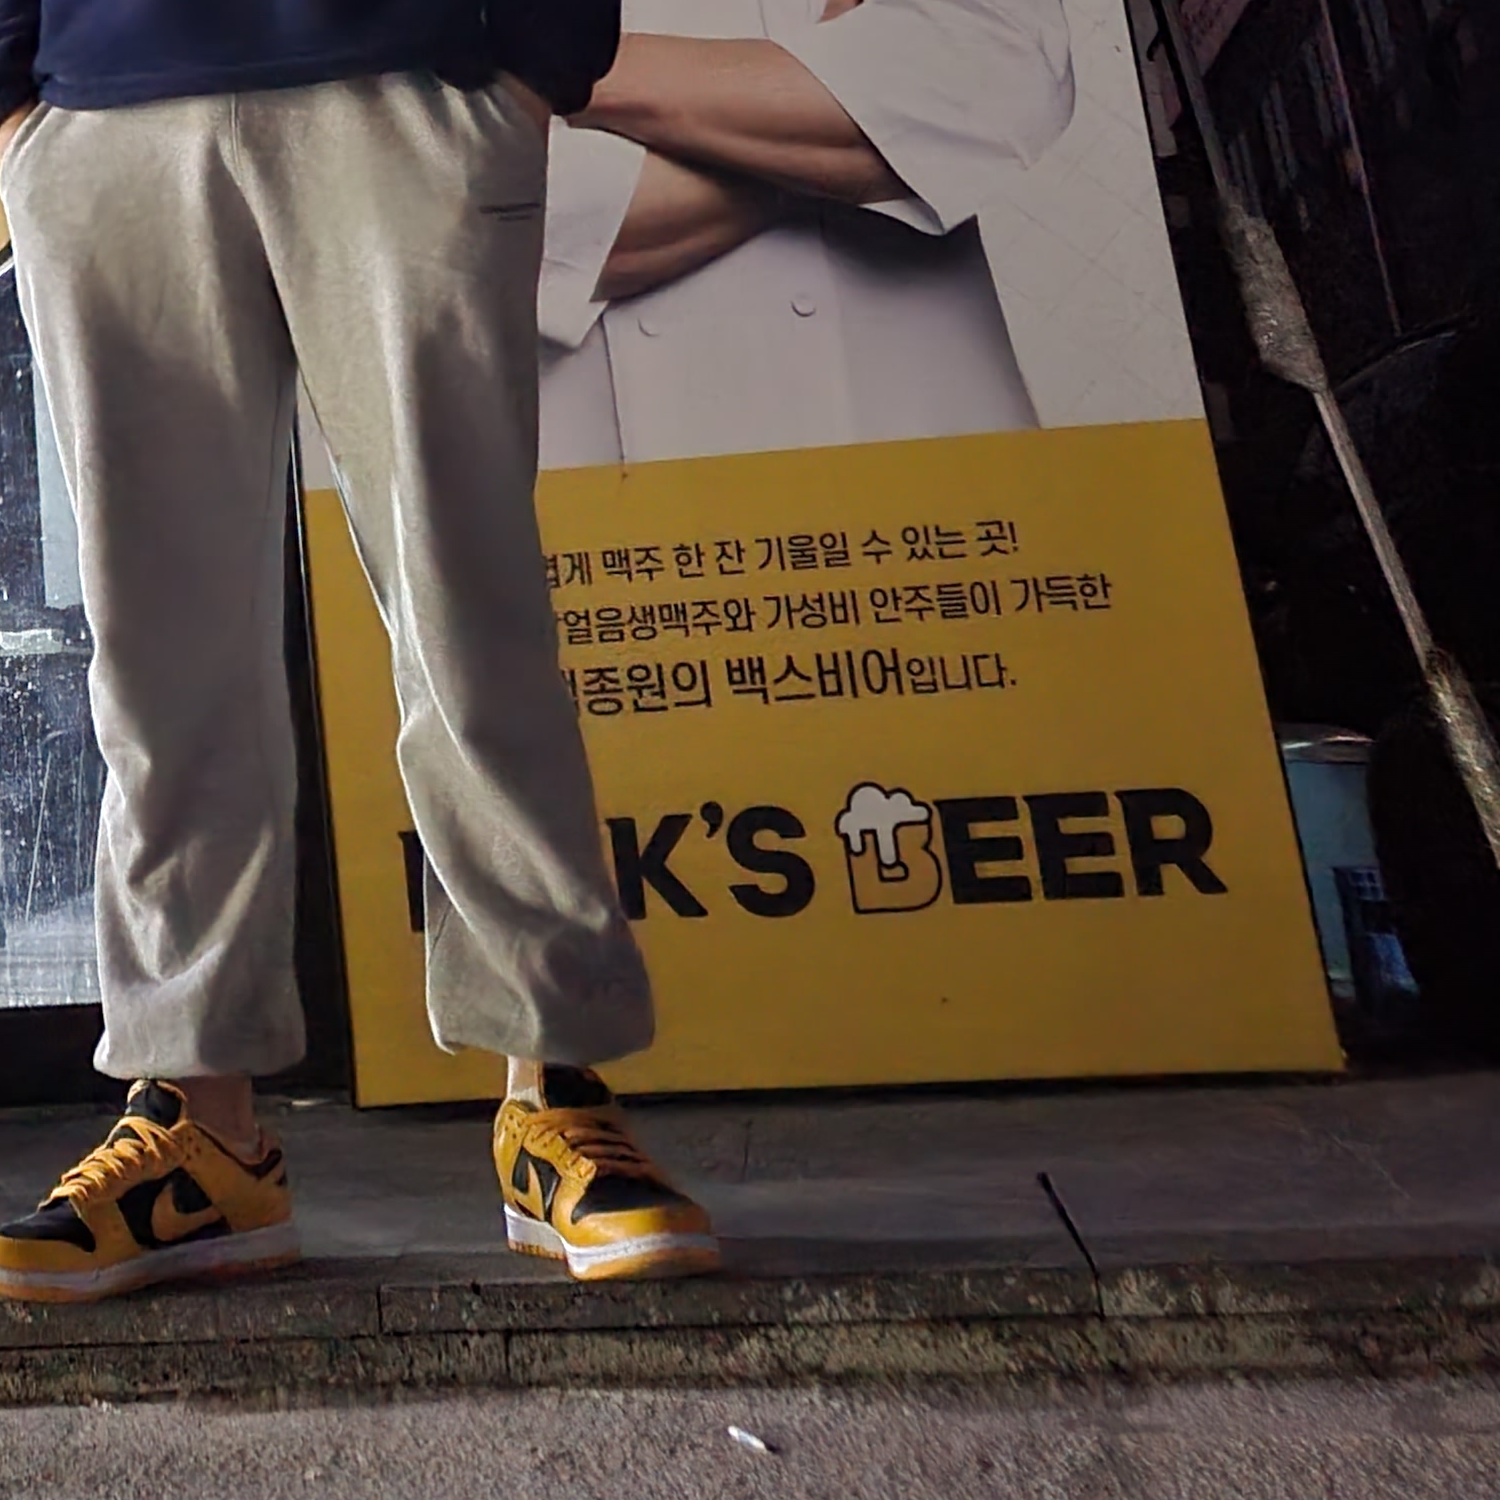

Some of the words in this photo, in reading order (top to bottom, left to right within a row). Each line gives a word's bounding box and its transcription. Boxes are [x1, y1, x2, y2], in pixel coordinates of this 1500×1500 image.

[601, 546, 664, 583] 맥주
[672, 542, 706, 579] 한
[714, 539, 746, 575] 잔
[754, 531, 852, 572] 기울일
[861, 529, 893, 565] 수
[901, 524, 967, 562] 있는
[975, 519, 1019, 557] 곳!
[556, 597, 757, 646] 얼음생맥주와
[763, 589, 860, 630] 가성비
[869, 579, 1003, 625] 안주들이
[1010, 572, 1112, 613] 가득한
[725, 648, 1018, 706] 백스비어입니다.
[834, 780, 1229, 916] BEER
